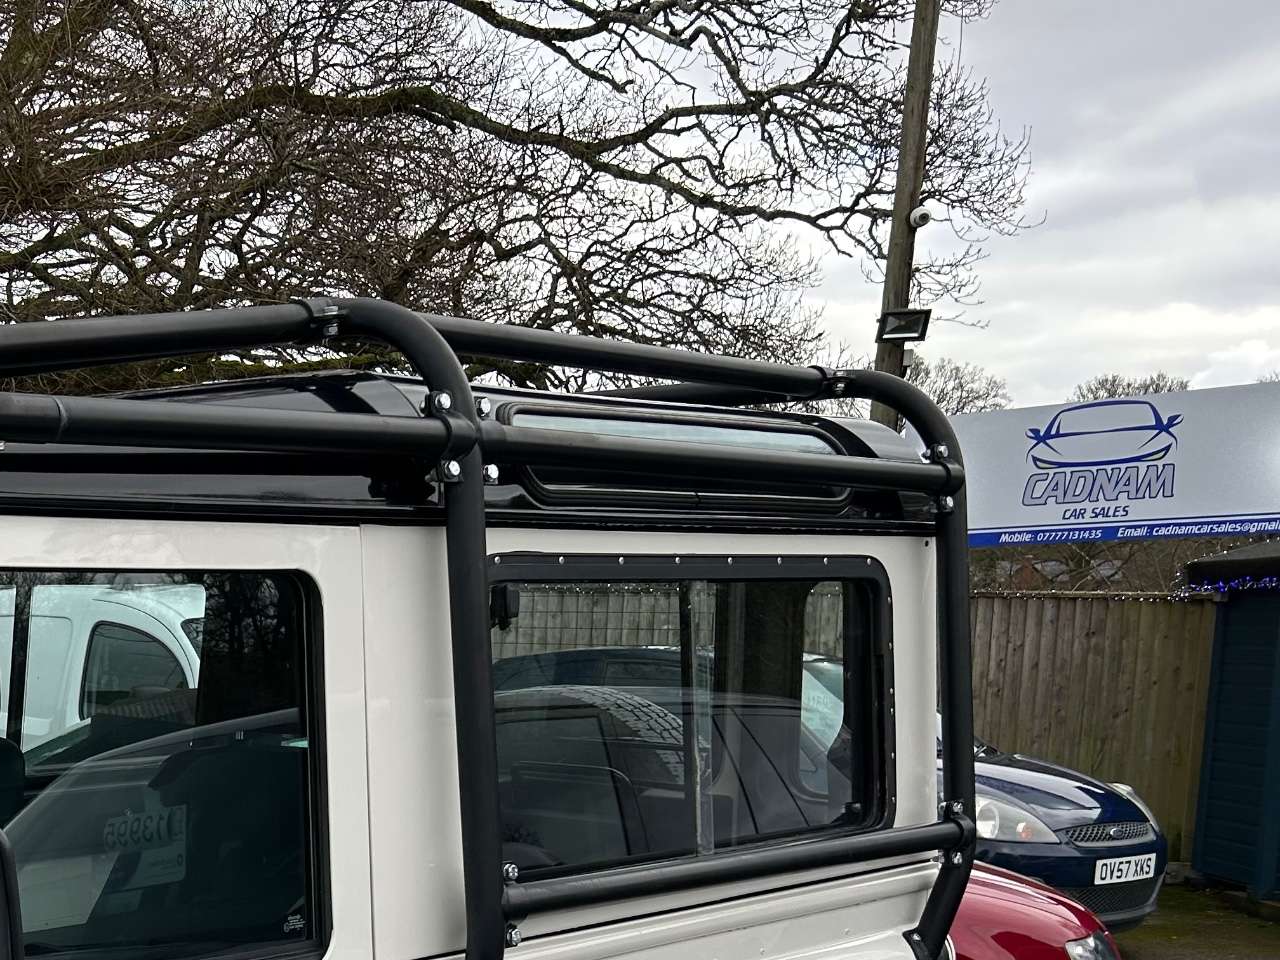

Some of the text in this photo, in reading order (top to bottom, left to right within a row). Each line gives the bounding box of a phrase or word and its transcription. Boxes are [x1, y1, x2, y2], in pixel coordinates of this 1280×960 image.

[1022, 464, 1175, 506] CADNAM
[1062, 505, 1130, 521] CAR SALES
[999, 520, 1280, 543] Mobile: 07777131435 Email: cadnamcarsales@gmai
[1100, 857, 1152, 880] OV57 XKS
